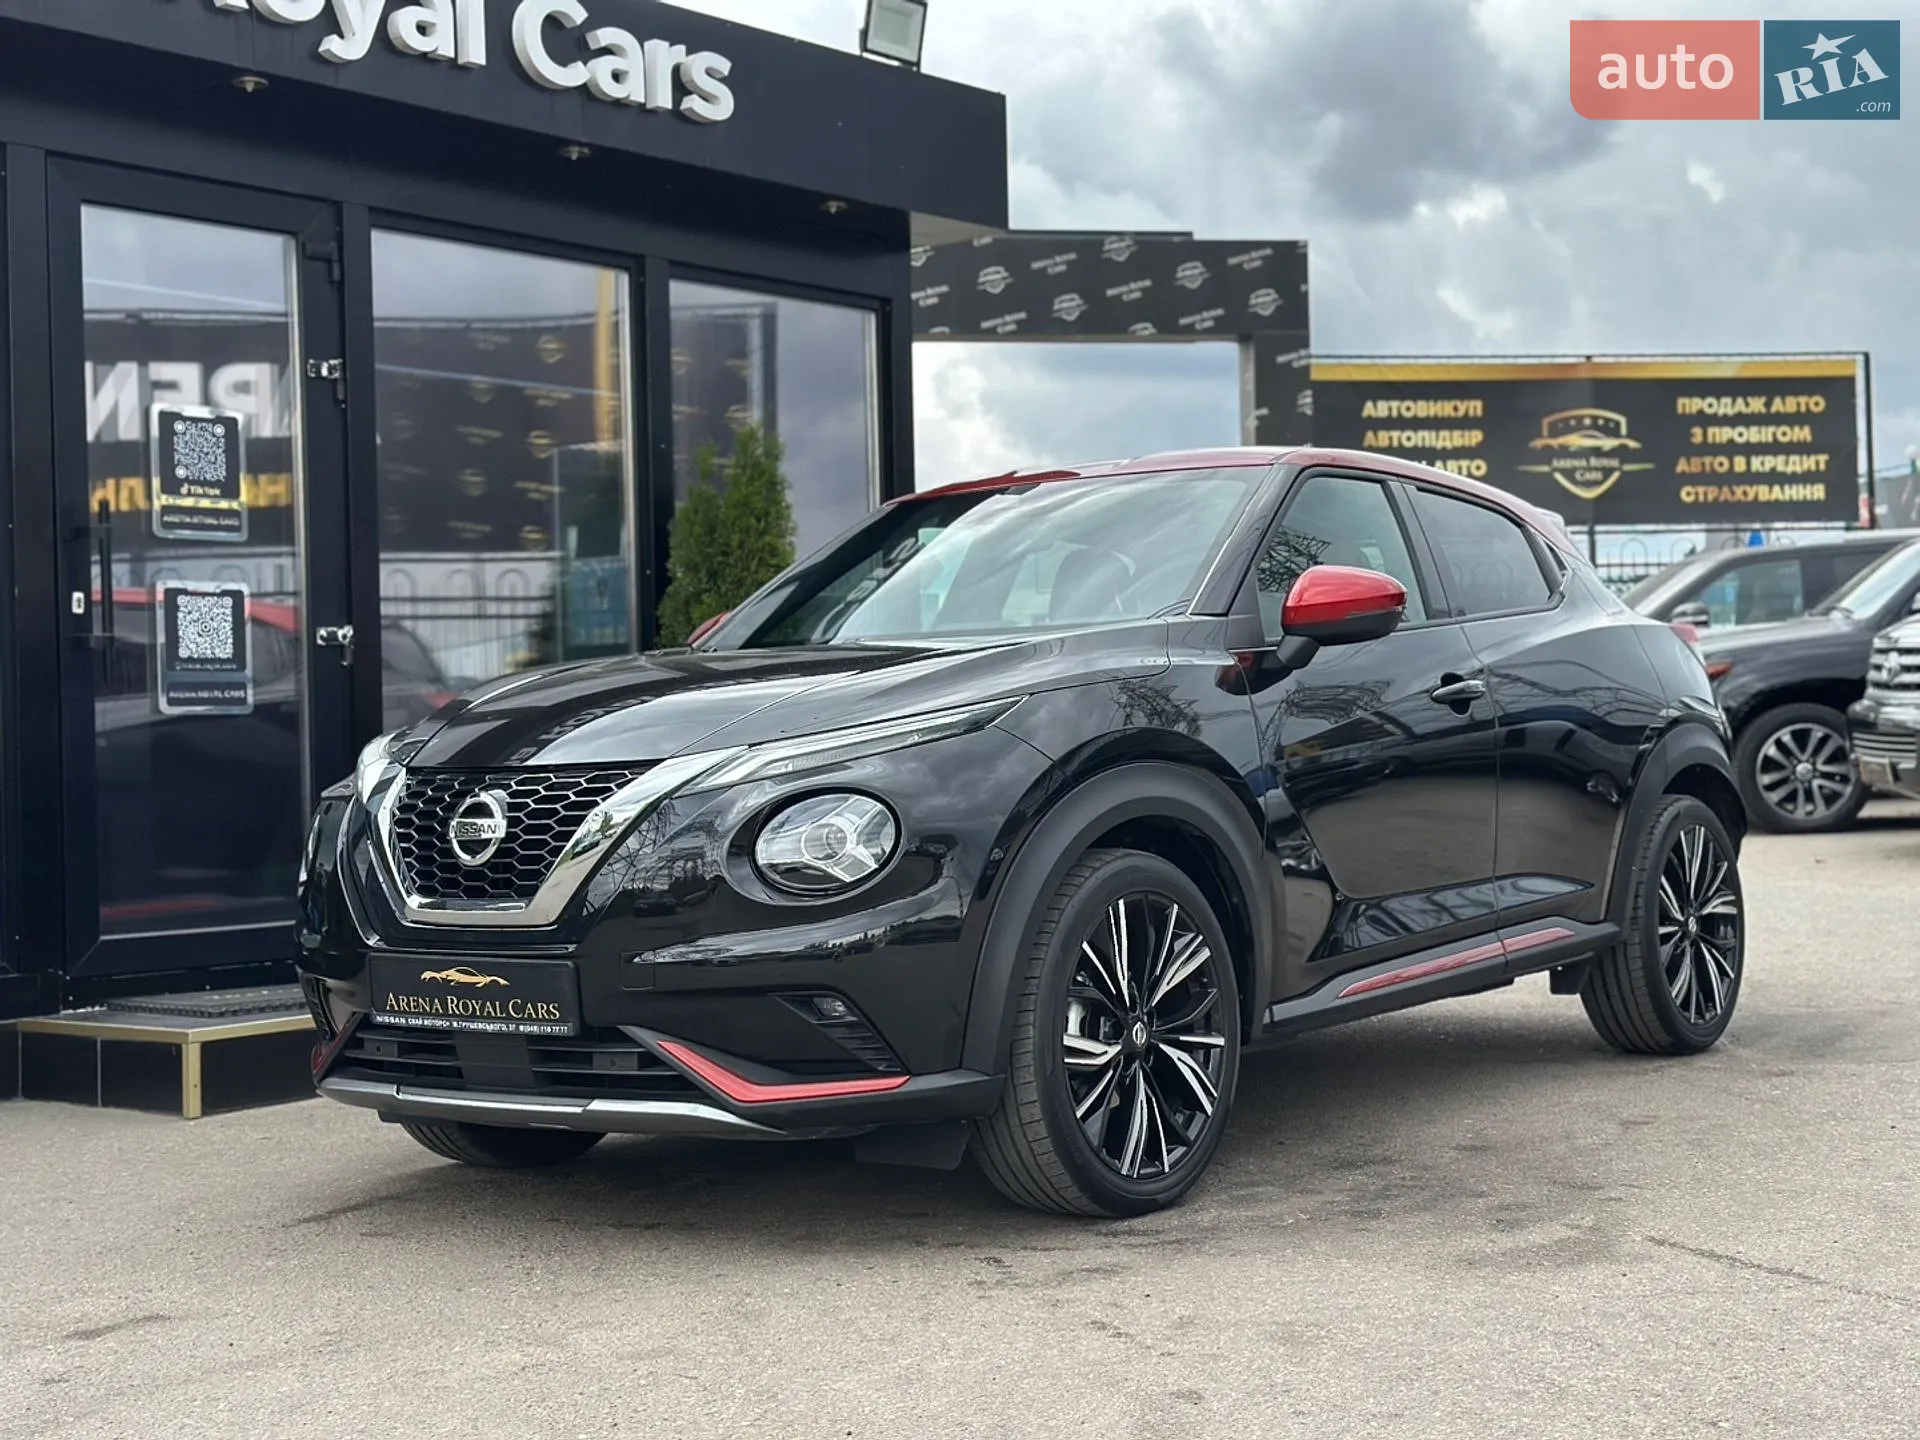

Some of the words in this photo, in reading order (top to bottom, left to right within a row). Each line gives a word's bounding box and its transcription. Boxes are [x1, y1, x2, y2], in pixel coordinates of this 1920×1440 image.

[511, 0, 735, 123] Cars
[1362, 399, 1483, 418] АВТОВИКУП
[1676, 396, 1767, 417] ПРОДАЖ
[1770, 394, 1826, 413] АВТО
[1363, 429, 1484, 450] АВТОПІДБІР
[1707, 425, 1812, 443] ПРОБІГОМ
[1676, 455, 1730, 474] АВТО
[1733, 455, 1746, 472] В
[1750, 453, 1829, 474] КРЕДИТ
[1680, 483, 1826, 503] СТРАХУВАННЯ
[450, 822, 498, 836] NISSAN
